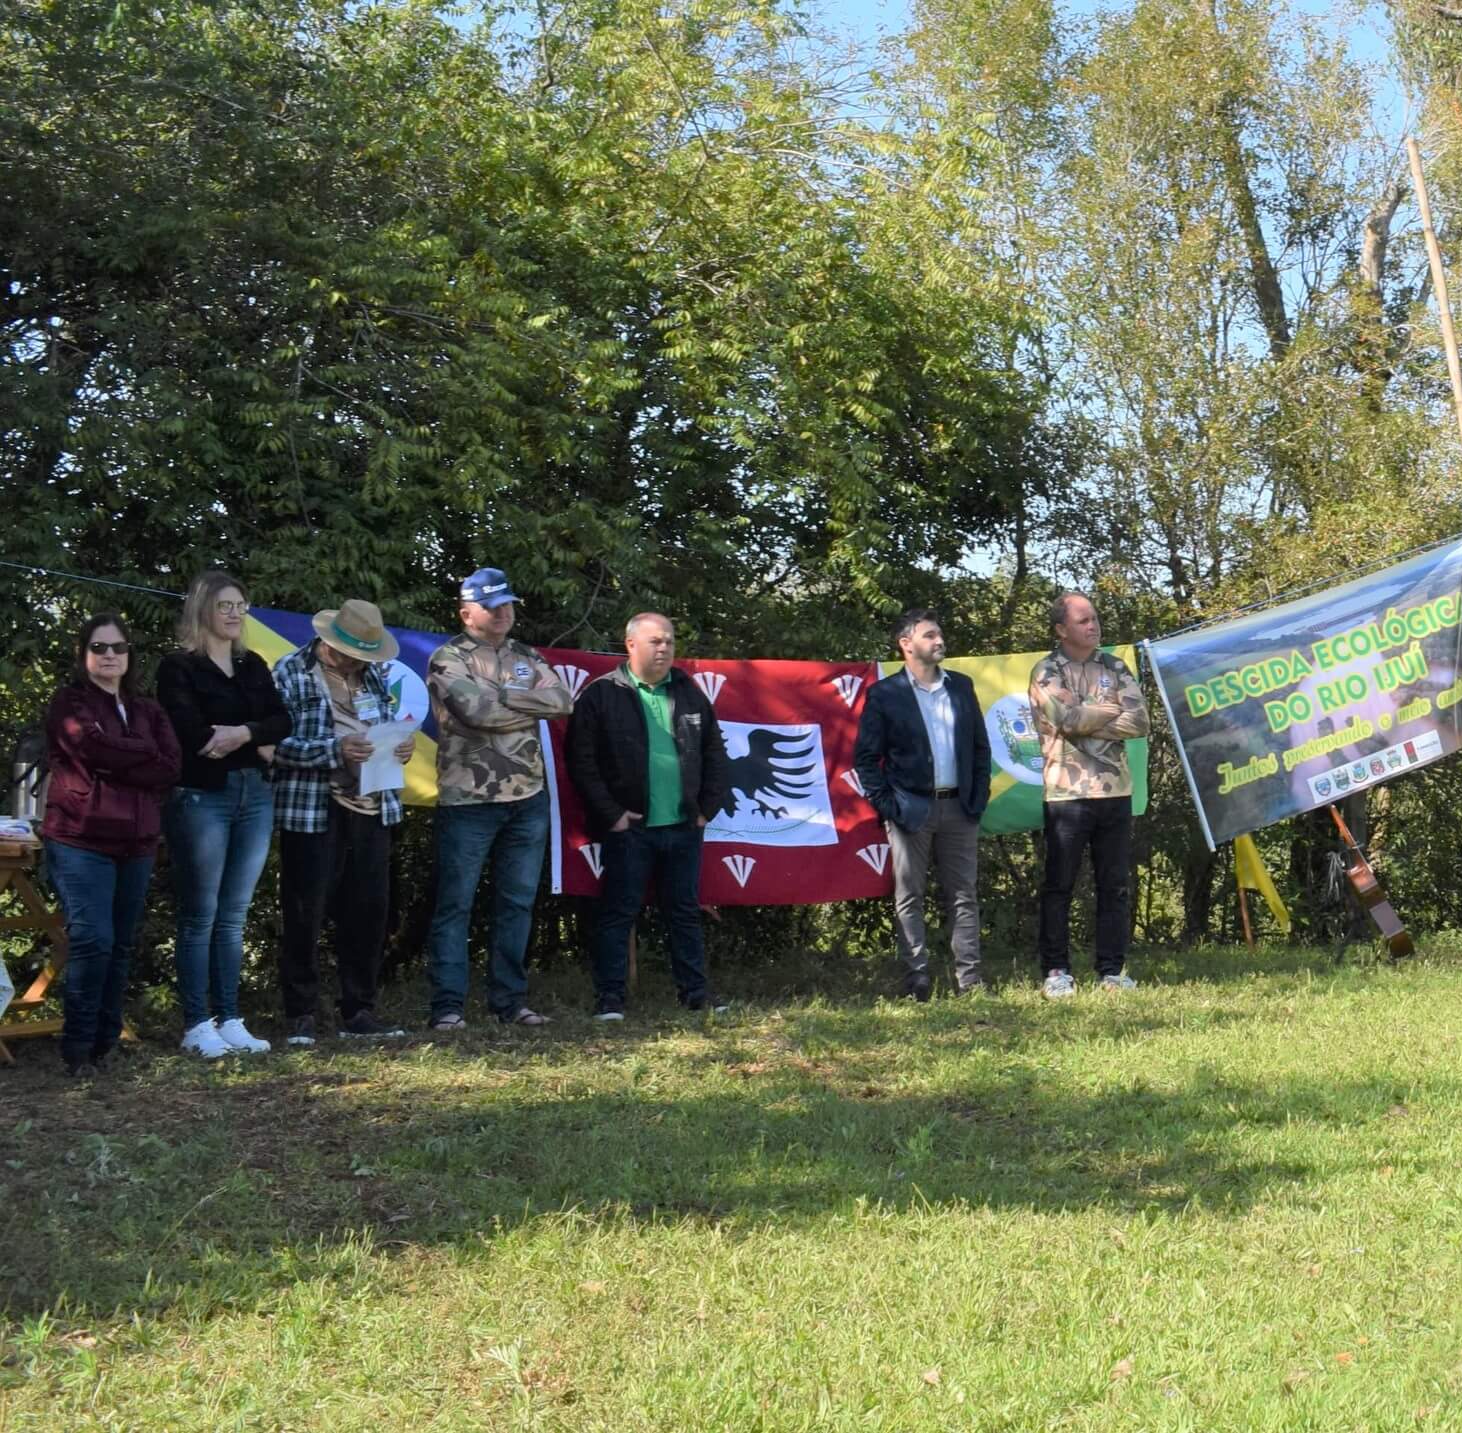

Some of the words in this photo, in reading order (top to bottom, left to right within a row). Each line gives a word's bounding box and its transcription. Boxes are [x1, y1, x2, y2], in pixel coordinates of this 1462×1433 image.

[1184, 650, 1313, 717] DESCIDA
[1264, 692, 1312, 733] DO
[1316, 674, 1368, 714] RIO
[1373, 641, 1428, 692] IJUÍ
[1217, 752, 1278, 794] Juntos
[1283, 715, 1373, 772] preservando
[1378, 713, 1392, 731] o
[1397, 697, 1432, 724] meio
